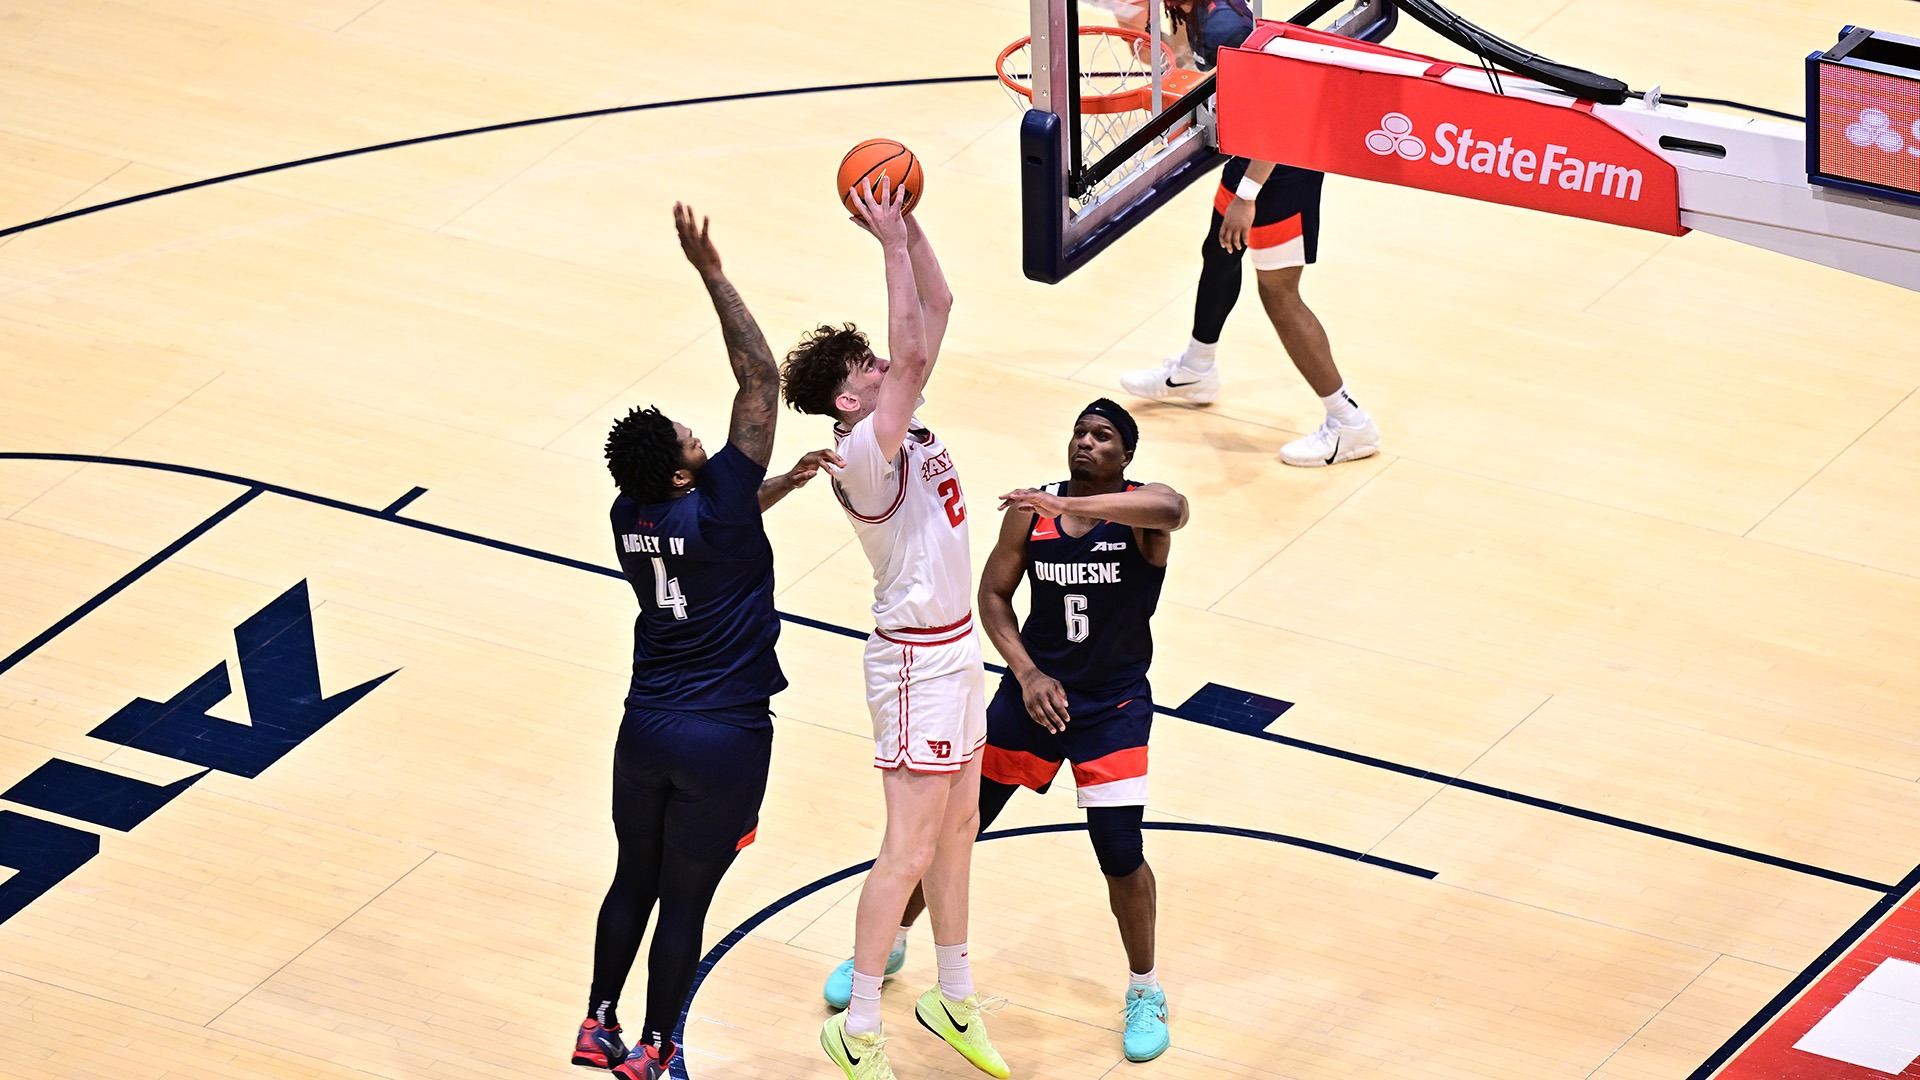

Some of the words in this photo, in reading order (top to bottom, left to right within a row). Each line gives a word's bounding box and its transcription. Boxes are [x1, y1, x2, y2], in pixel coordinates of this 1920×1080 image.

[669, 537, 685, 555] IV
[1090, 541, 1127, 552] A10
[1035, 560, 1122, 586] DUQUESNE
[651, 557, 688, 620] 4
[1064, 594, 1090, 643] 6
